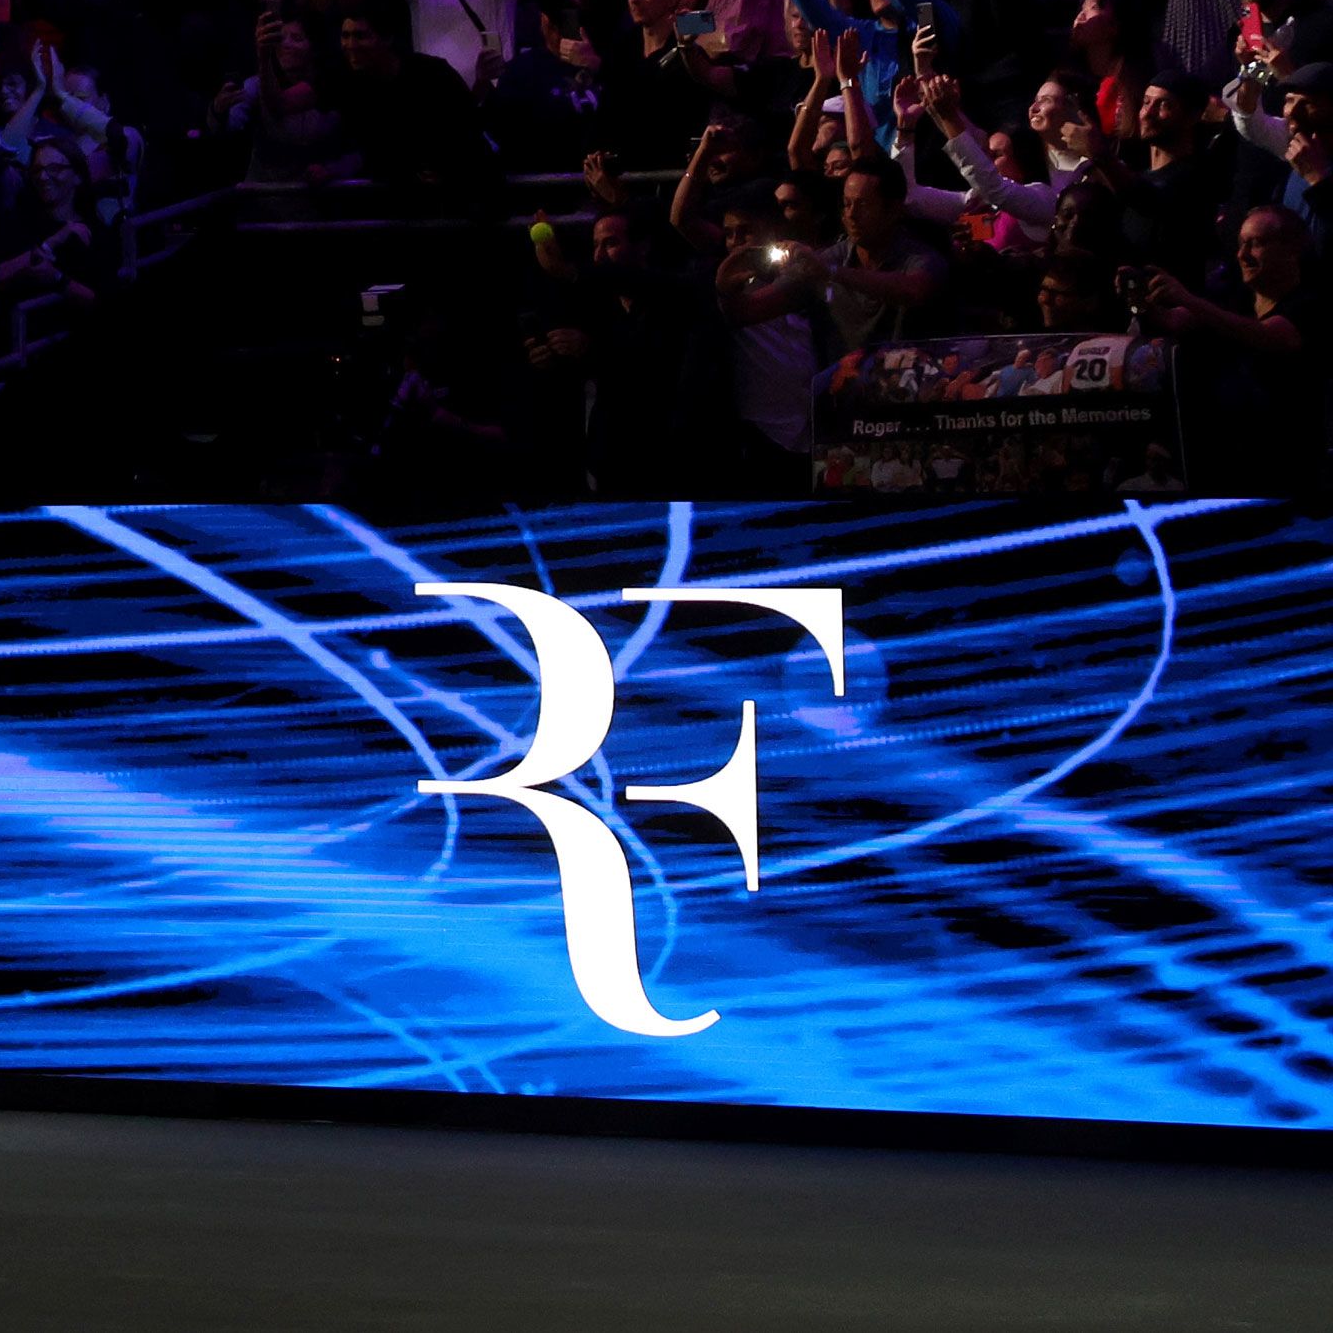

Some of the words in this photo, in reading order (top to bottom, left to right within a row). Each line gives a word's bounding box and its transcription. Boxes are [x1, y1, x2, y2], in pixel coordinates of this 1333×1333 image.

[1075, 358, 1107, 381] 20
[853, 419, 901, 437] Roger
[934, 412, 996, 431] Thanks
[1000, 410, 1024, 428] for
[1028, 408, 1057, 427] the
[1061, 404, 1152, 424] Memories
